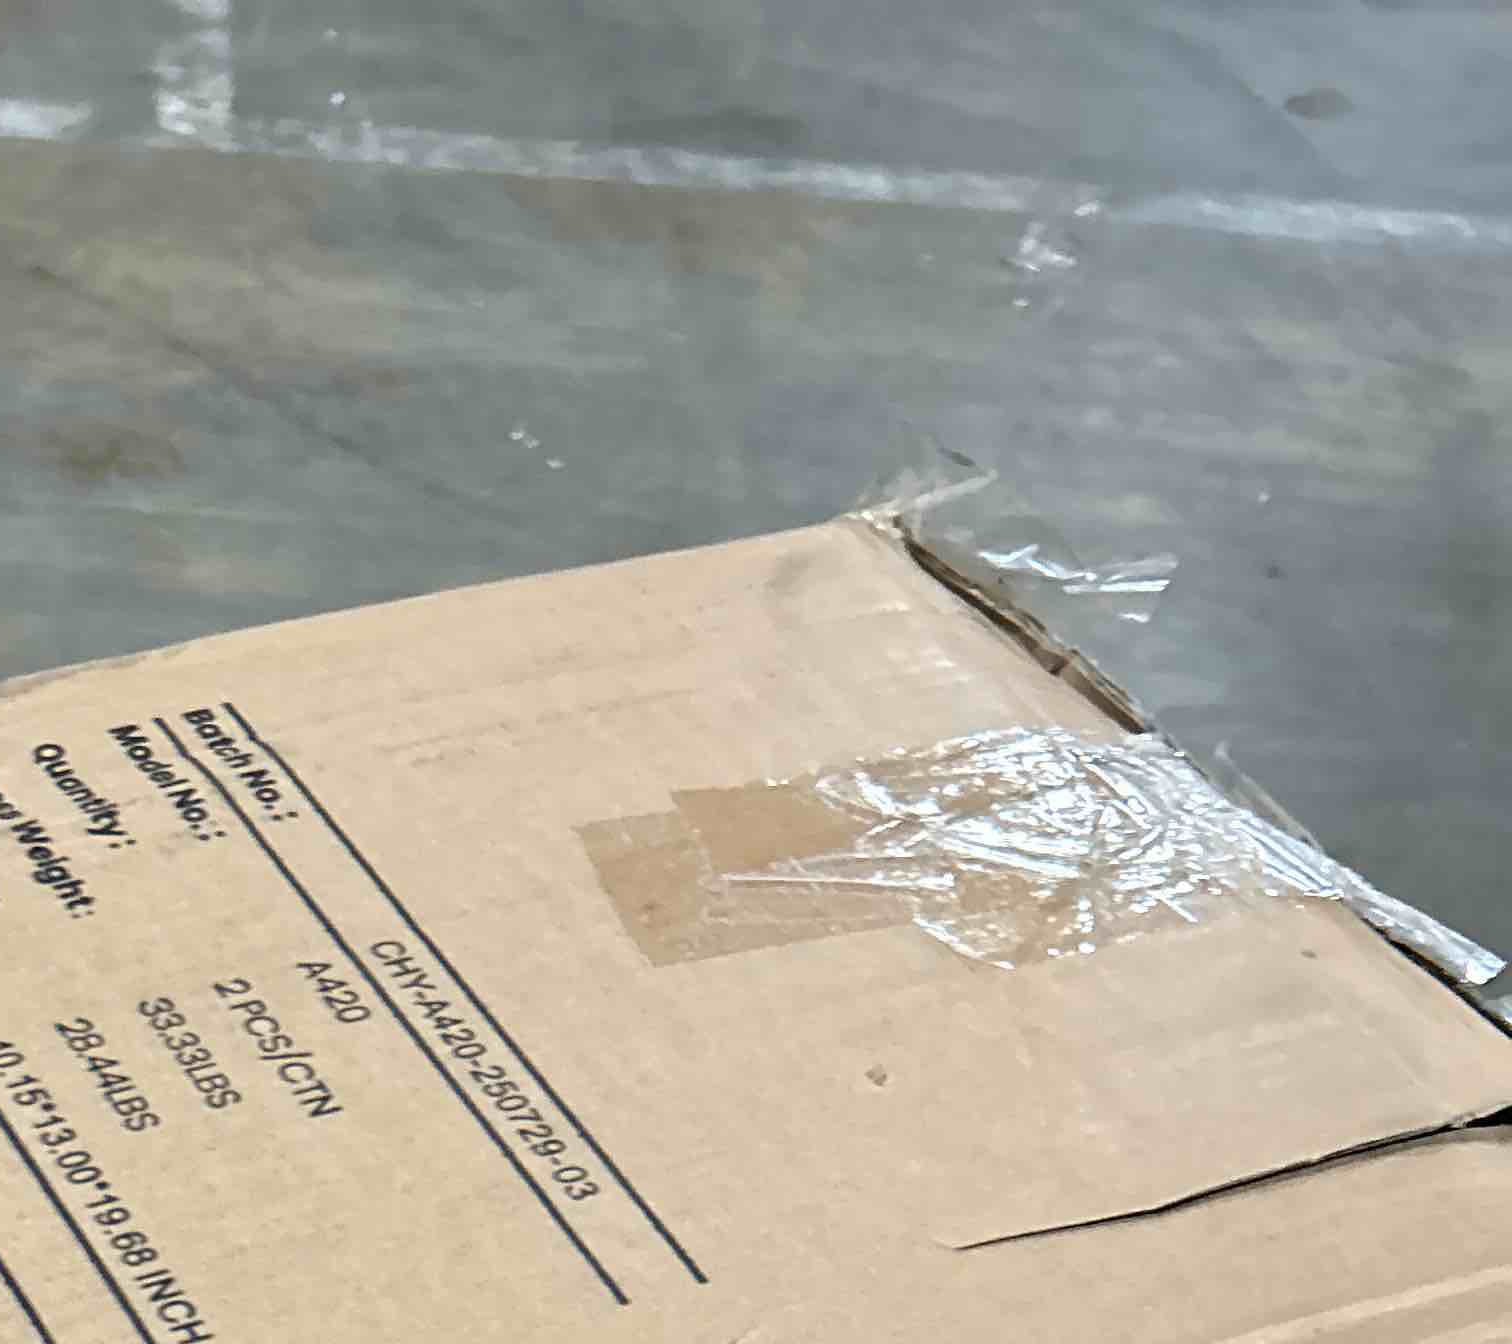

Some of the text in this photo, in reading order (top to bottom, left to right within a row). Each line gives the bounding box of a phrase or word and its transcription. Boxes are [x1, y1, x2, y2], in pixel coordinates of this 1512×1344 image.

[107, 723, 189, 789] Model
[180, 707, 254, 769] Batch
[213, 977, 345, 1120] 2 PCS/CTN
[296, 959, 372, 1025] A420
[53, 1017, 162, 1133] 28.44LBS
[137, 996, 243, 1110] 33.33LBS
[368, 940, 600, 1201] CHY-A420-250729-03
